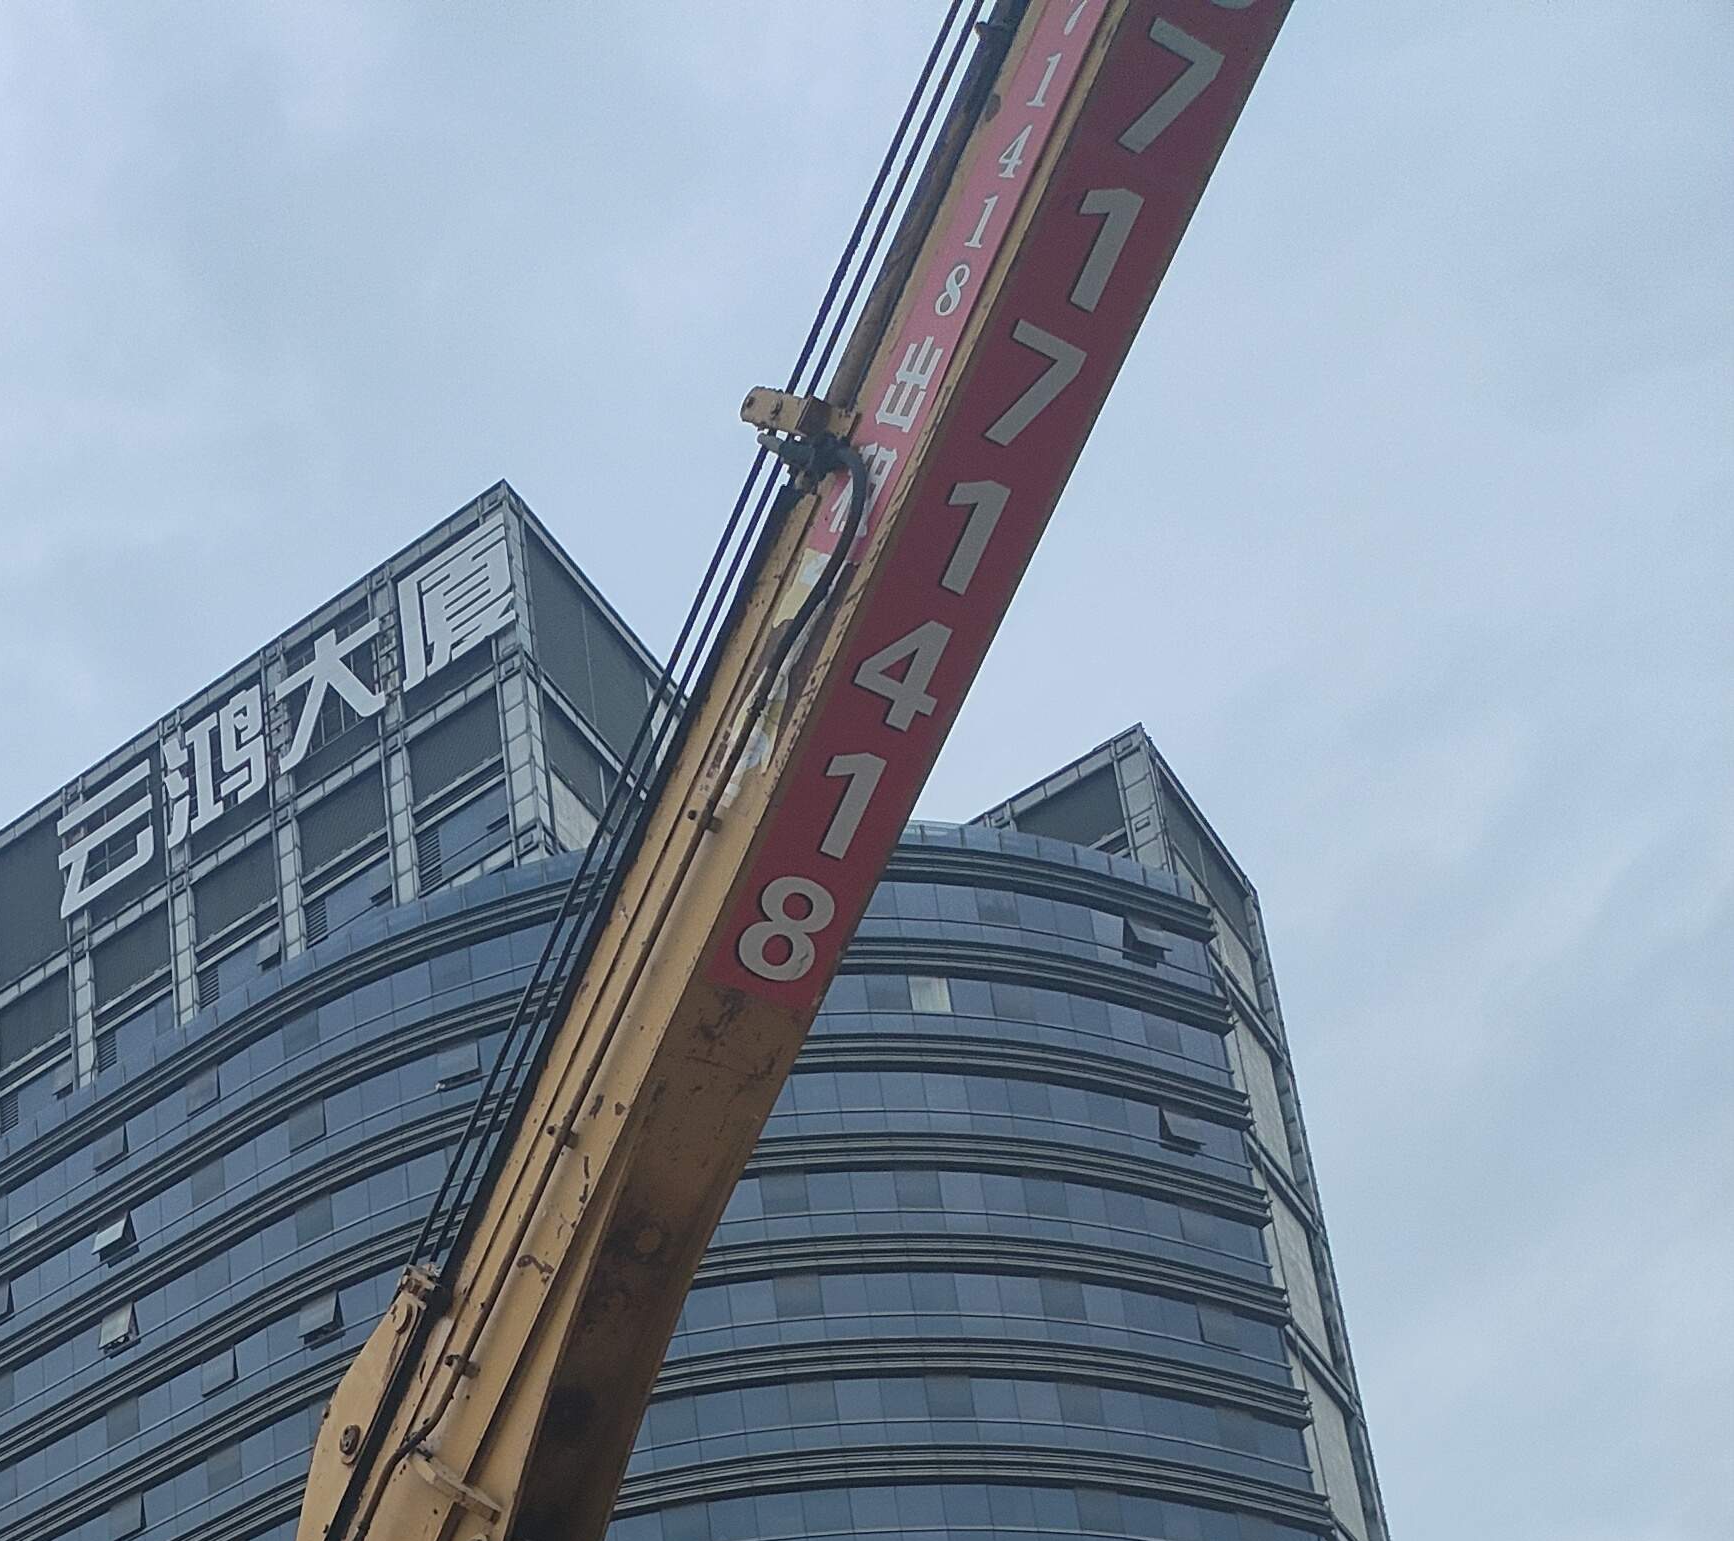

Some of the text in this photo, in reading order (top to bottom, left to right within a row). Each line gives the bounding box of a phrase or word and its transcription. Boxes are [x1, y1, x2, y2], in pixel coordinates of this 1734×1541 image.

[56, 511, 517, 919] 云鸿大厦
[739, 0, 1254, 982] 7171418
